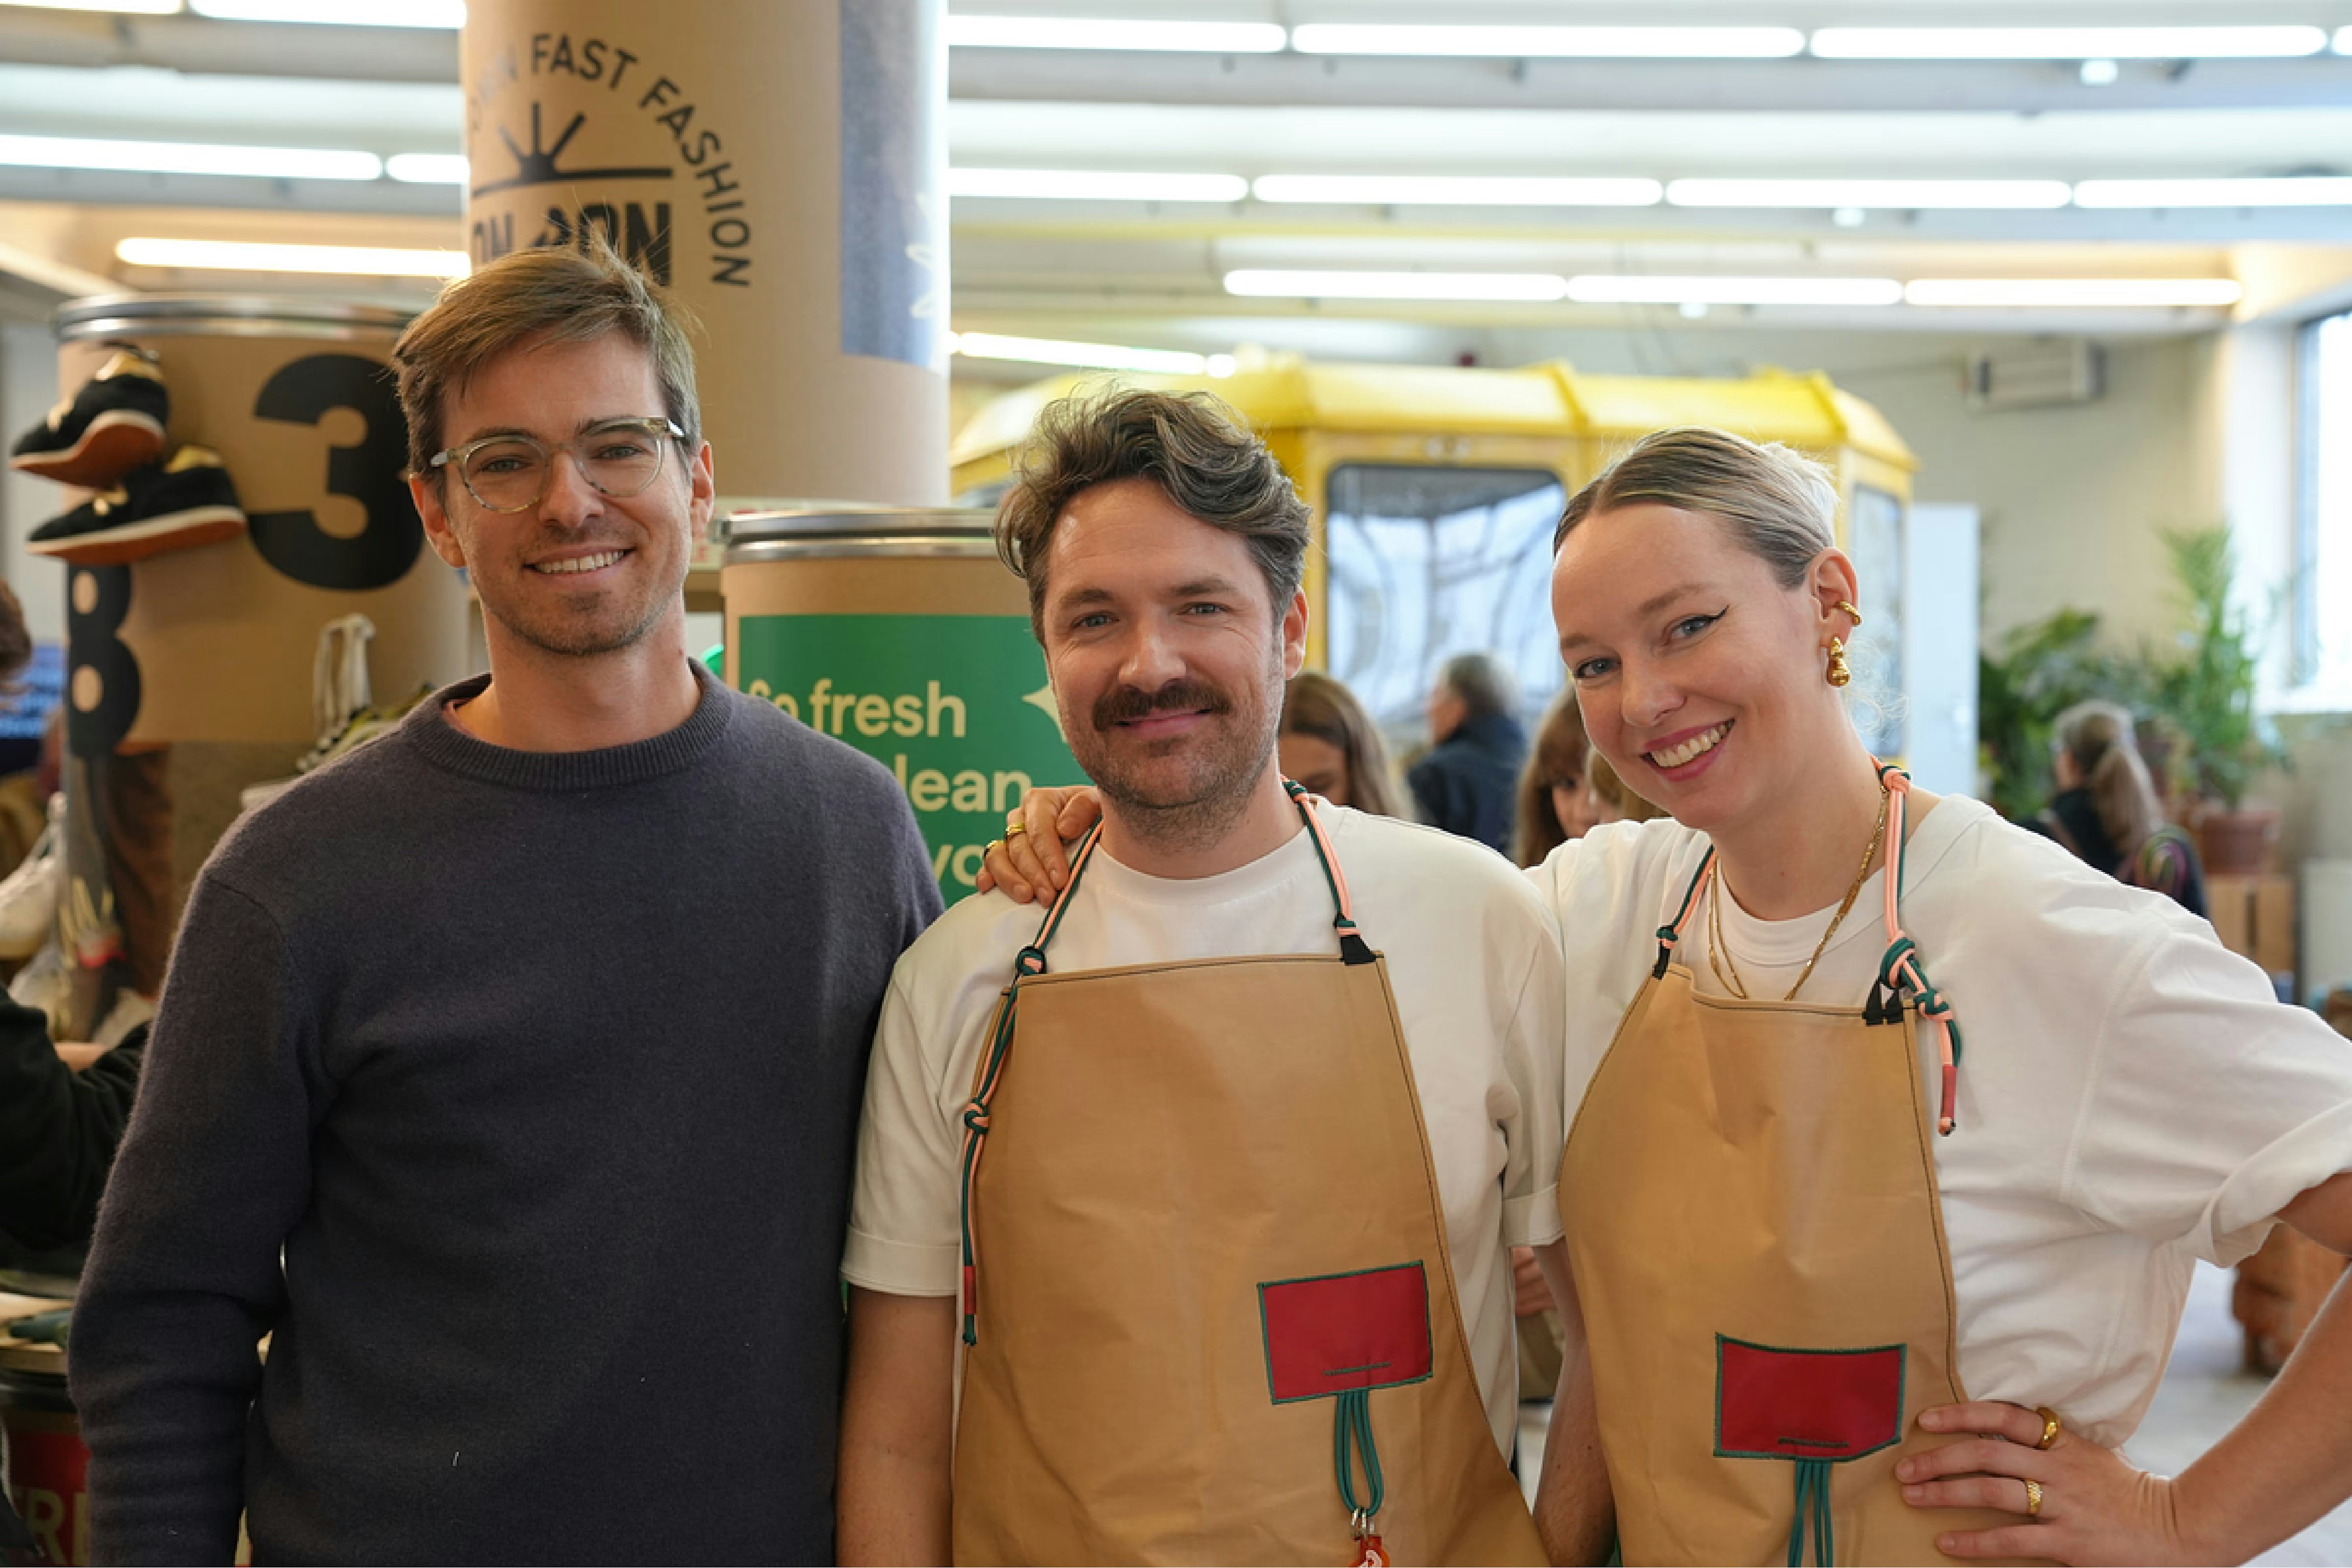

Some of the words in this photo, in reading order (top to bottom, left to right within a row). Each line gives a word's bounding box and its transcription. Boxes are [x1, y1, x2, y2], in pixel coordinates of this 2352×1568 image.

[532, 34, 638, 90] FAST
[639, 76, 751, 287] FASHION
[248, 353, 425, 590] 3
[809, 677, 966, 738] fresh
